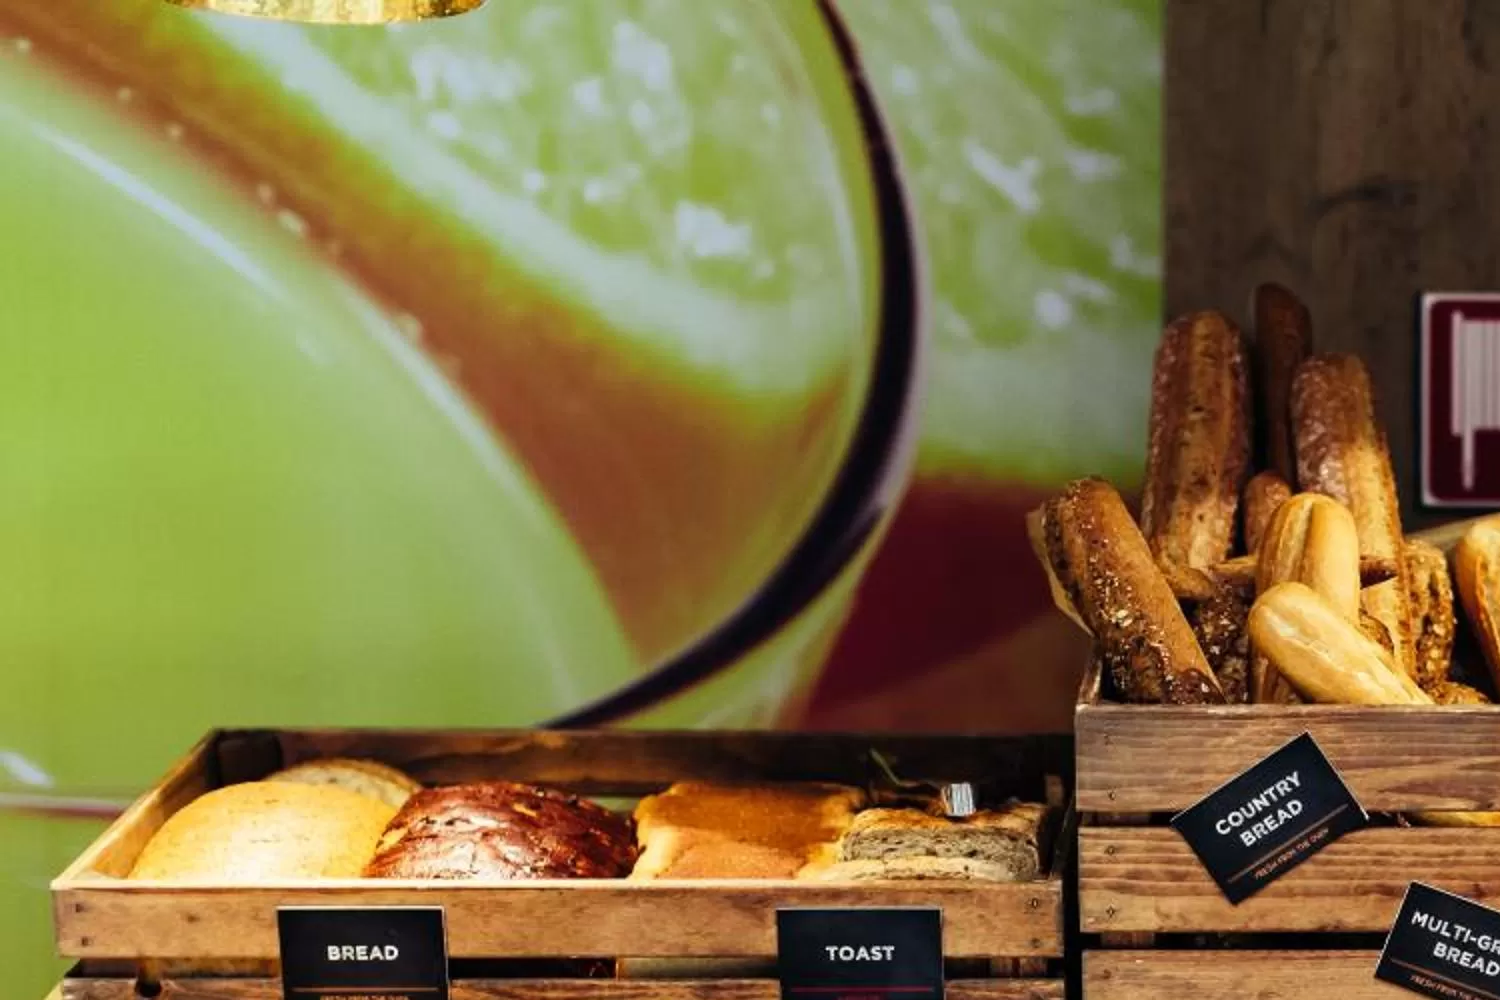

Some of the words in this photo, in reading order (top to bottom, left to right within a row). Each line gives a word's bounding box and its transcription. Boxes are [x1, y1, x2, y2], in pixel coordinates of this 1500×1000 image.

[1215, 771, 1301, 835] COUNTRY
[1240, 799, 1303, 847] BREAD
[327, 945, 399, 960] BREAD
[825, 945, 895, 960] TOAST
[1433, 942, 1500, 977] BREAD
